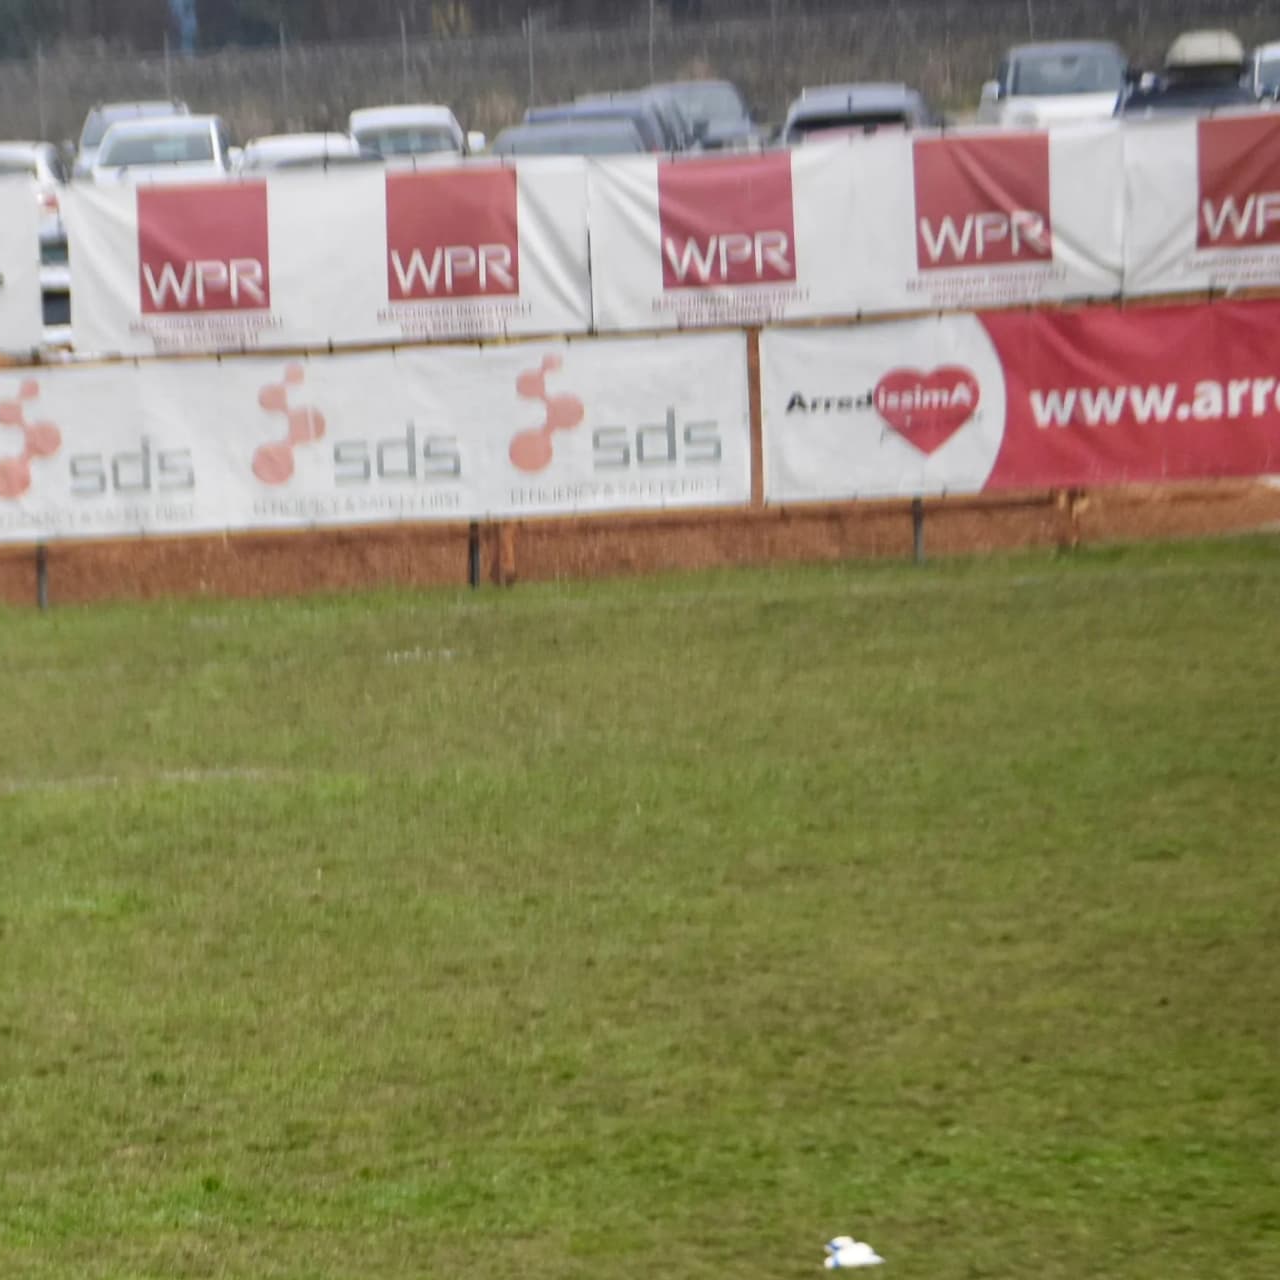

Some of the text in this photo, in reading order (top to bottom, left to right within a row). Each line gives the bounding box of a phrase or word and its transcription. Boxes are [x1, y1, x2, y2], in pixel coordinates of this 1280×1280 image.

[664, 231, 791, 282] WPR
[920, 211, 1052, 262] WPR
[142, 258, 265, 308] WPR
[391, 244, 514, 294] WPR
[1028, 374, 1280, 430] www.arr
[334, 421, 461, 486] sds
[592, 406, 722, 470] sds
[70, 437, 196, 496] sds
